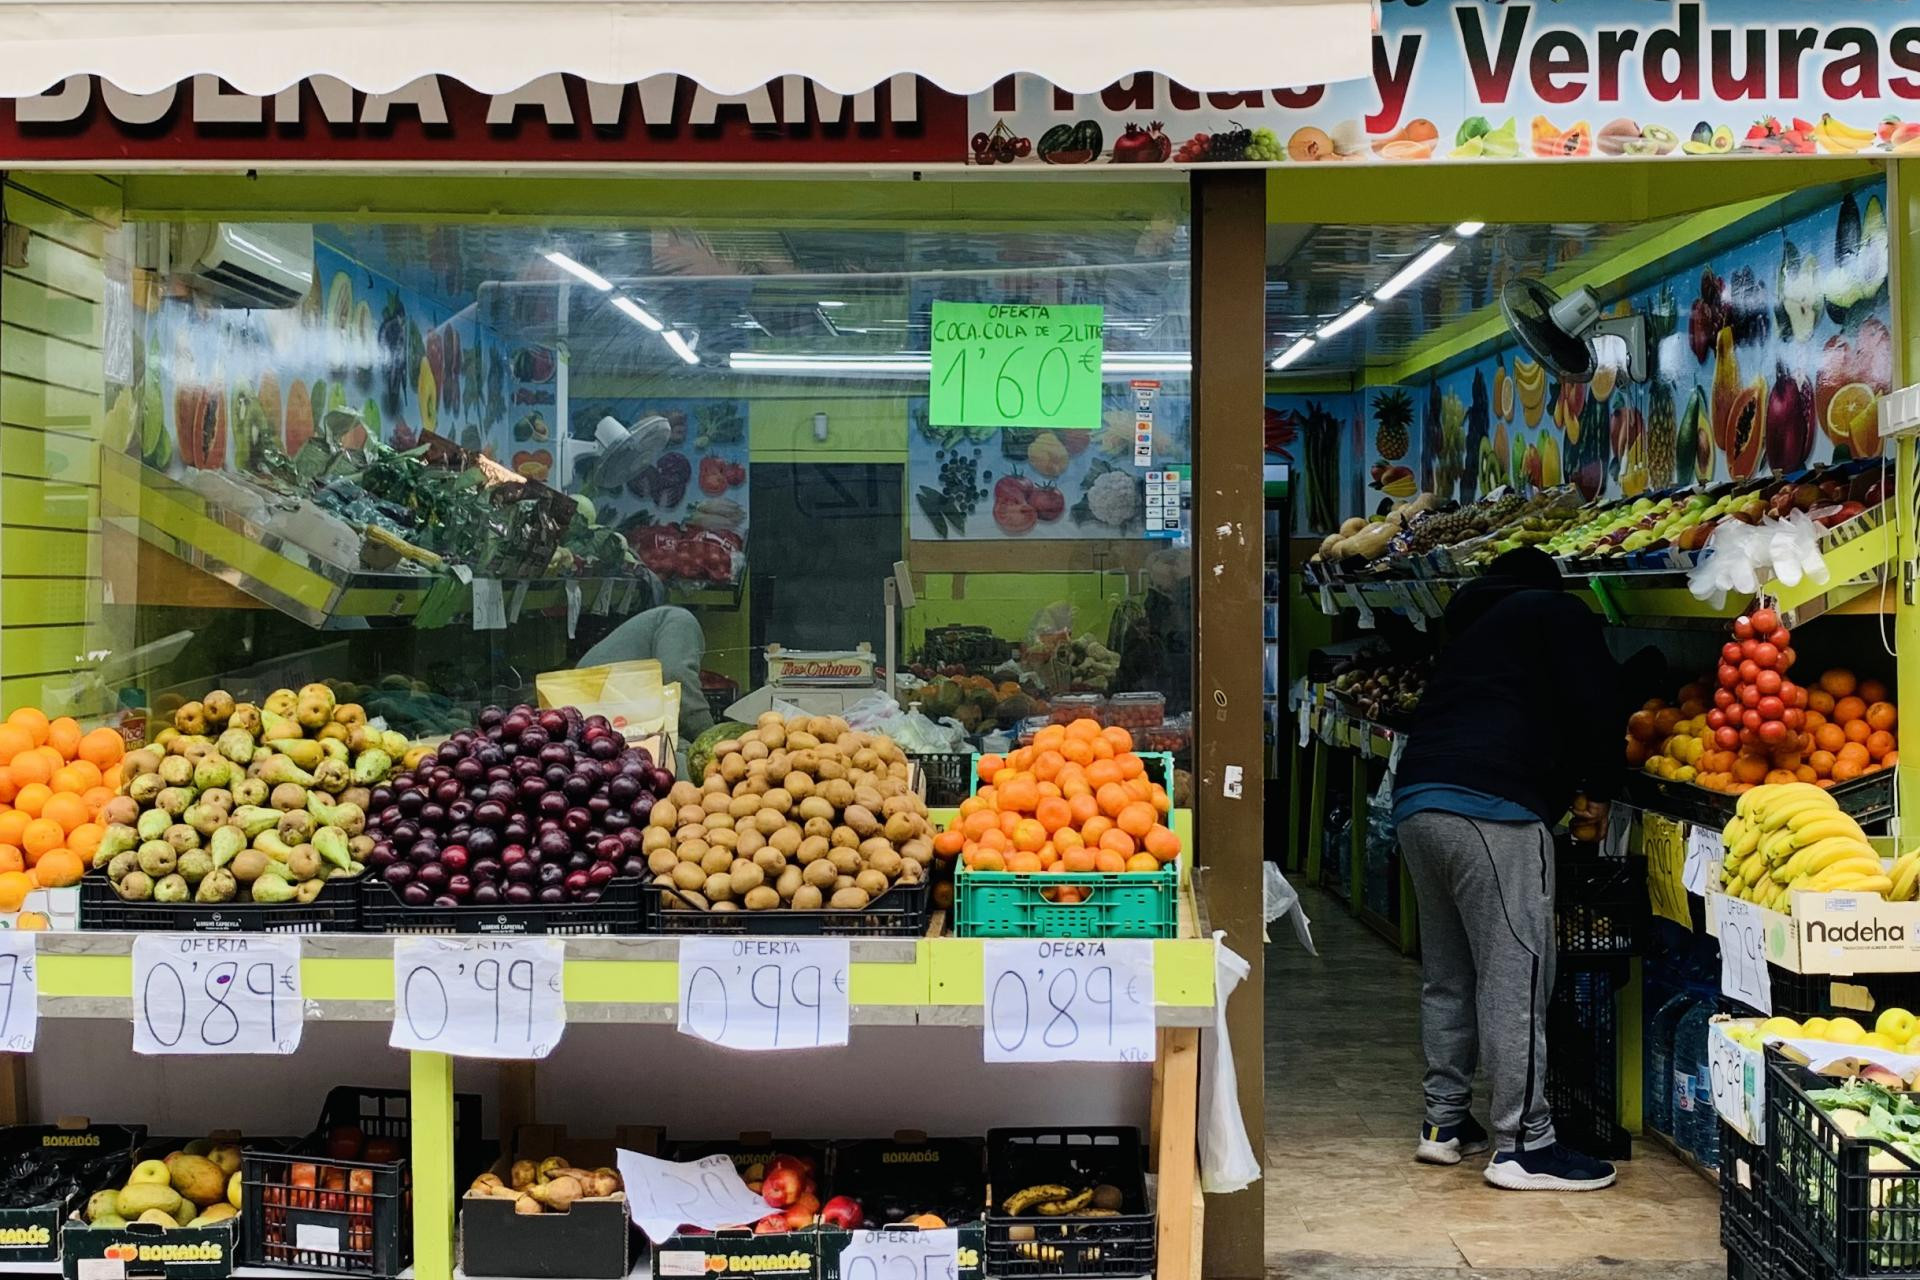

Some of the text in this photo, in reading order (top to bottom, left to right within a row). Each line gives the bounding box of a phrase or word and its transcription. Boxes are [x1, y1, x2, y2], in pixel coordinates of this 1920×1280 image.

[1365, 2, 1920, 135] y Verduras
[988, 305, 1050, 319] OFERTA
[1035, 325, 1050, 337] DE
[1807, 917, 1904, 942] nadeha
[181, 938, 248, 953] OFERTA
[732, 940, 801, 957] OFERTA
[1038, 942, 1107, 959] OFERTA
[864, 1231, 931, 1244] OFERTA
